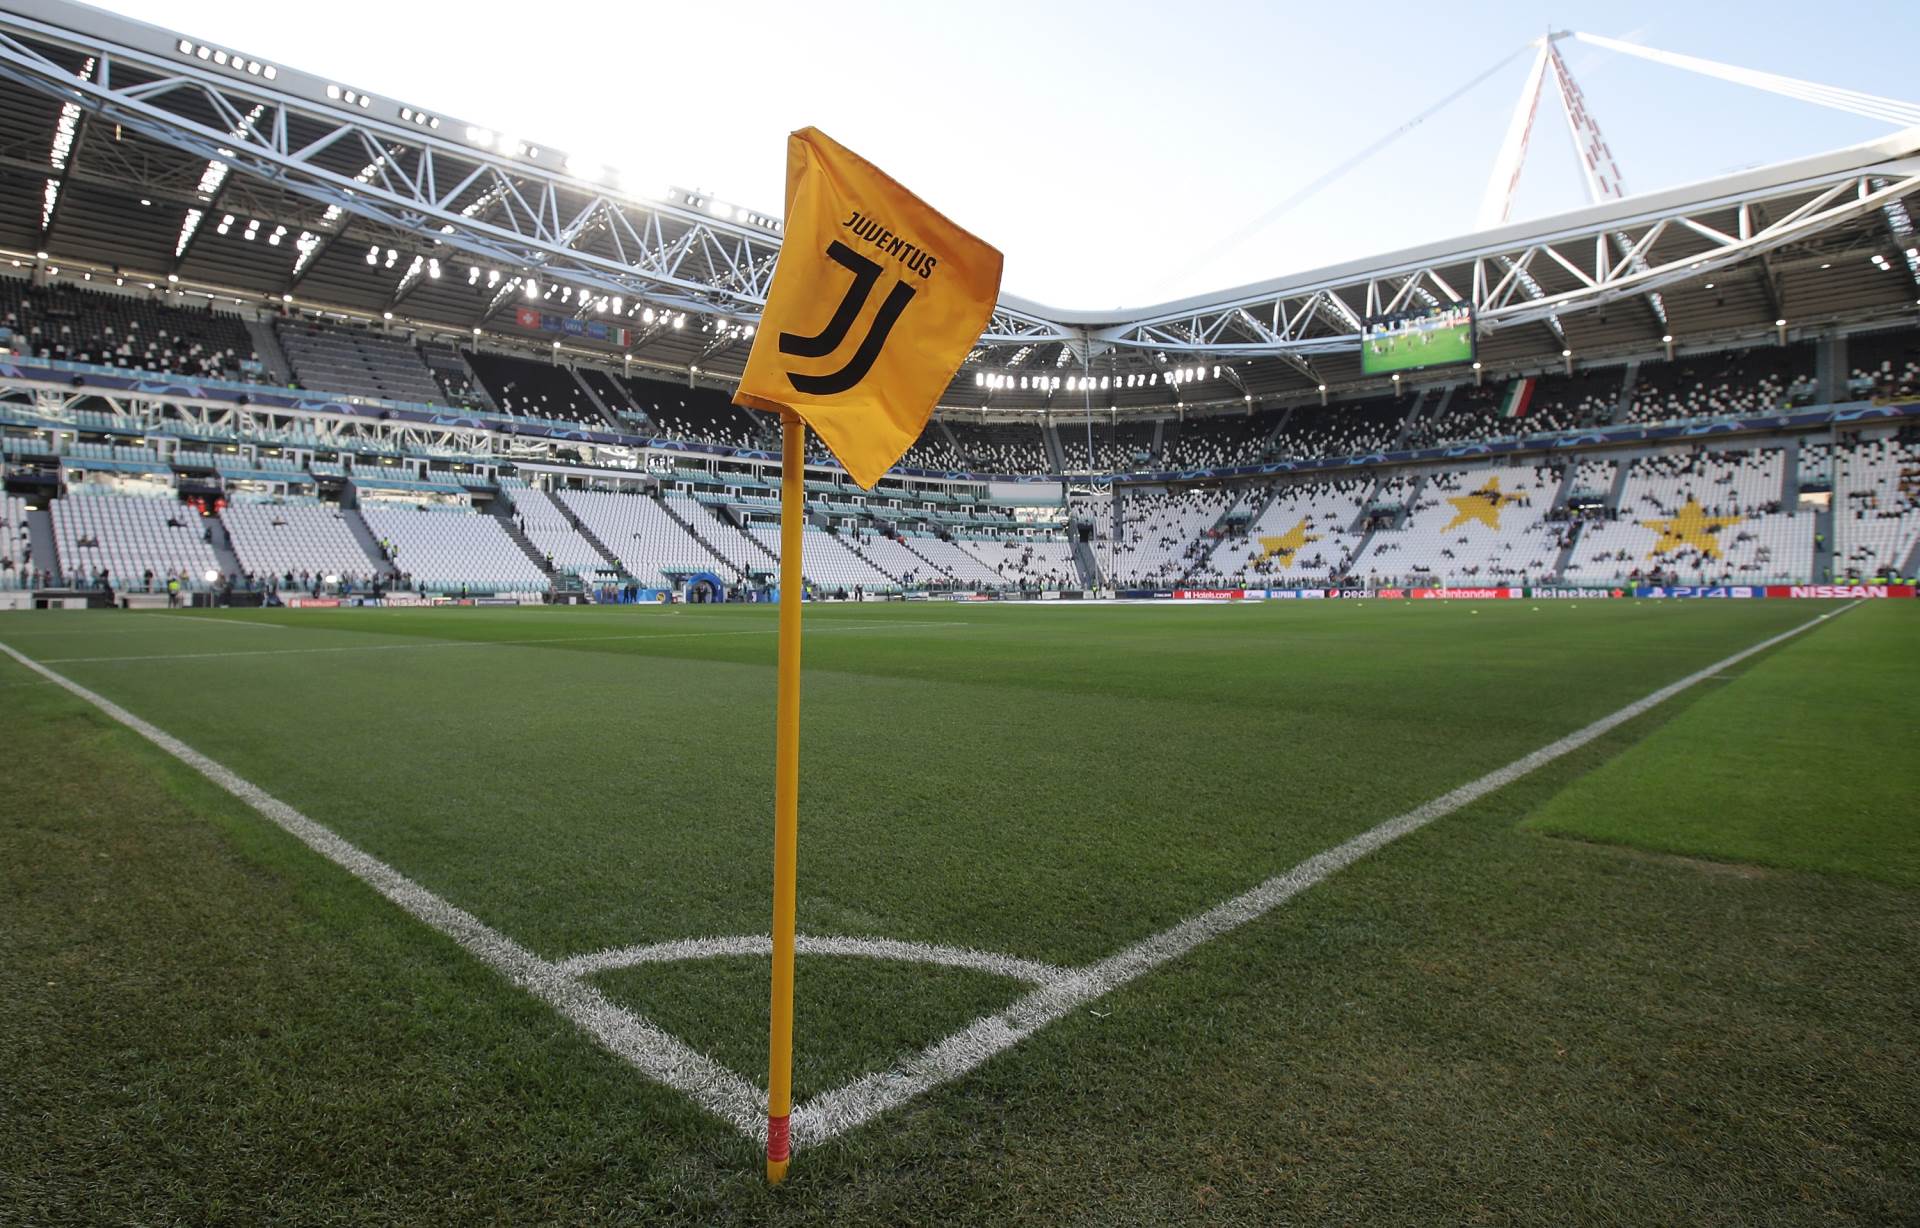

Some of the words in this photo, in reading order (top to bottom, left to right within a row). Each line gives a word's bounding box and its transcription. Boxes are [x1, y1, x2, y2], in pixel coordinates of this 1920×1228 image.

[842, 211, 937, 280] JUVENTUS
[1531, 587, 1609, 599] Heineken
[1672, 587, 1727, 598] PS4
[1790, 586, 1888, 598] NISSAN
